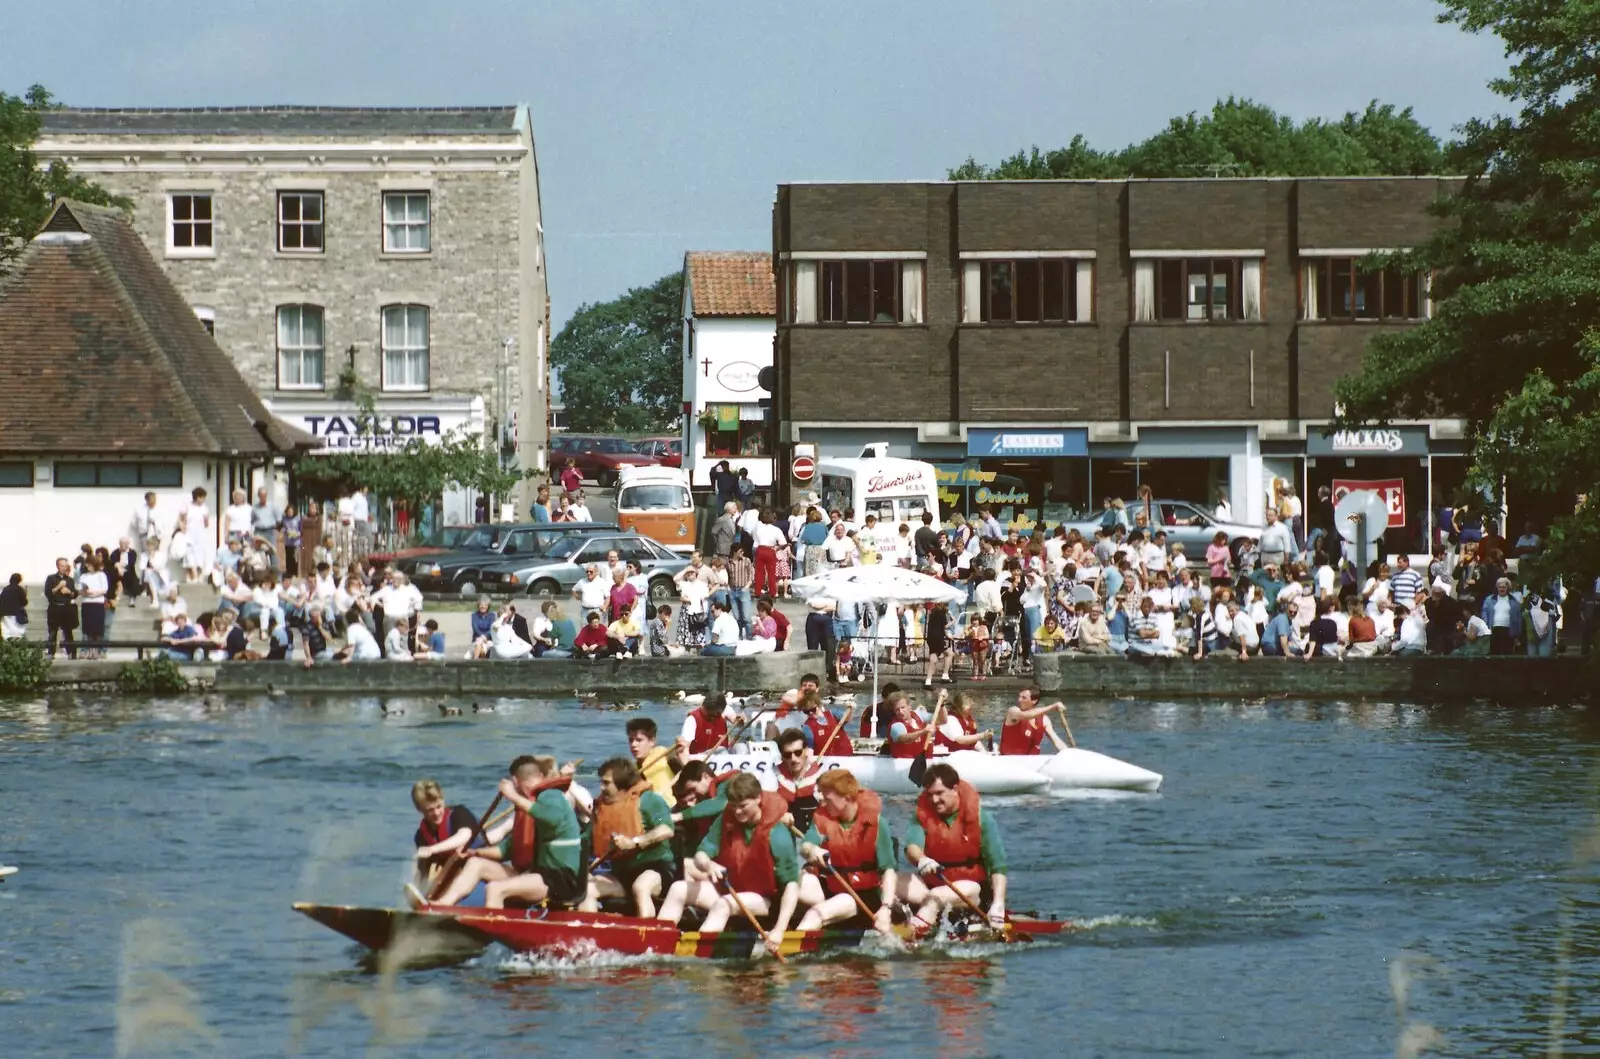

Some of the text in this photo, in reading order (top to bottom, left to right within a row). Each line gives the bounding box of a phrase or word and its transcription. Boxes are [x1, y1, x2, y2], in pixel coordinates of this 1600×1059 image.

[304, 415, 440, 435] TAYLOR
[318, 436, 420, 450] LECTRICA
[1333, 430, 1403, 451] MACKAYS
